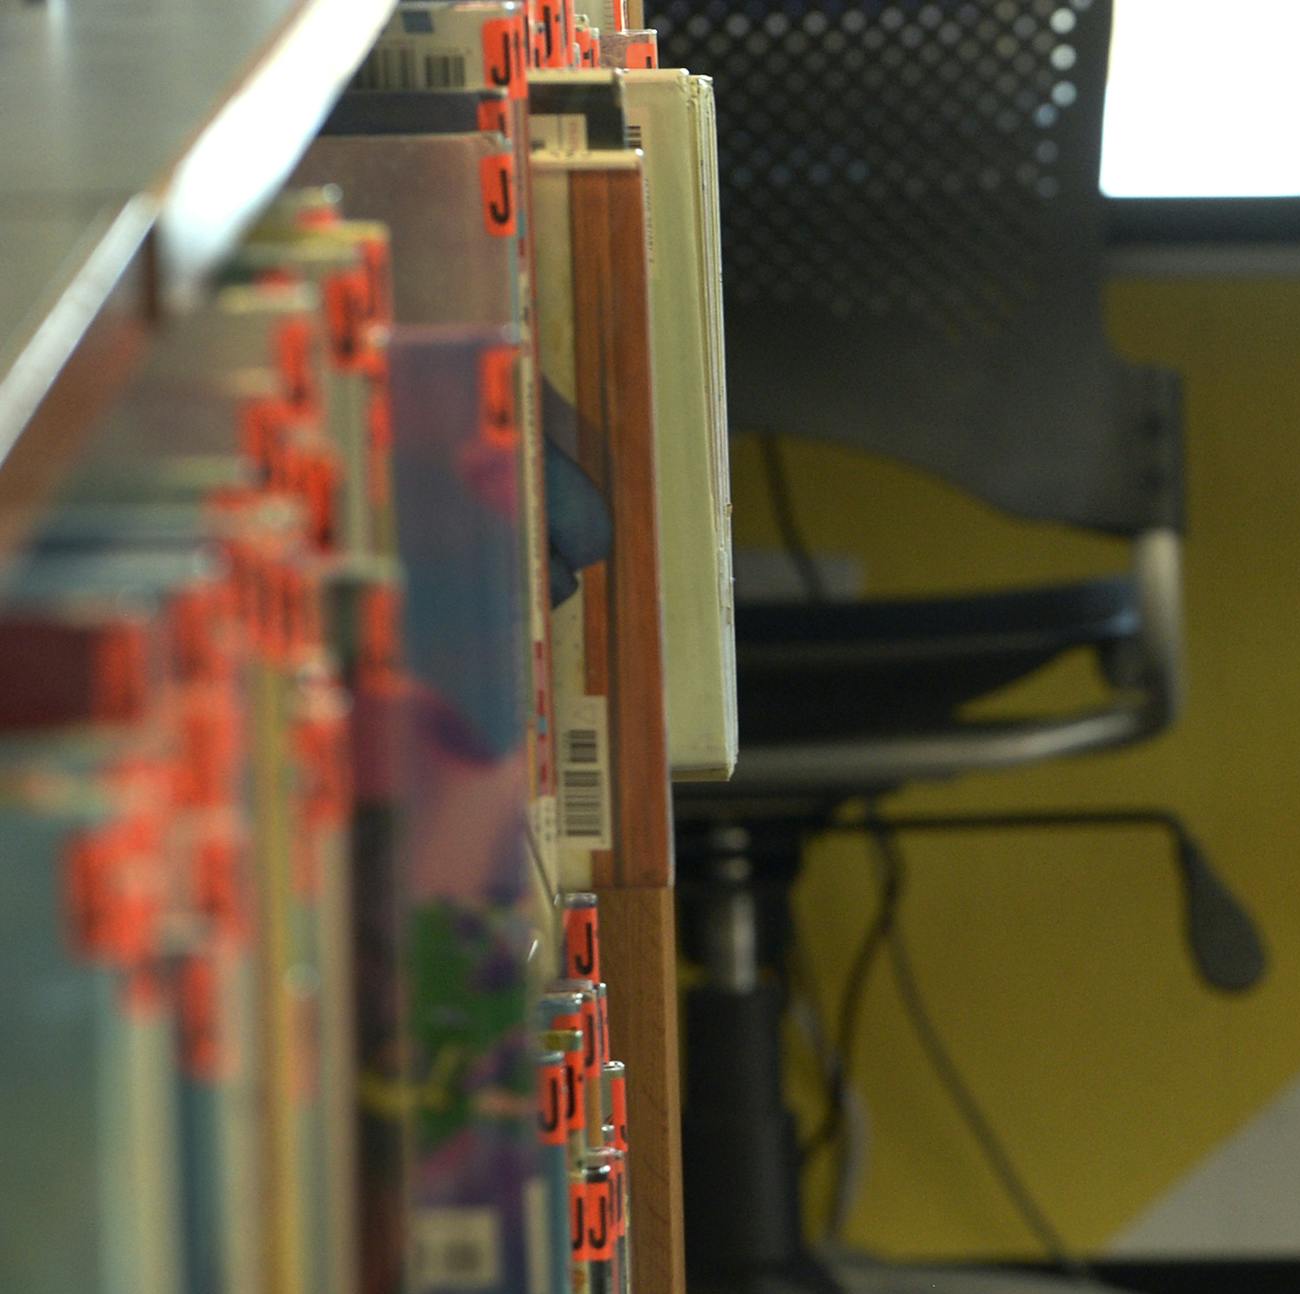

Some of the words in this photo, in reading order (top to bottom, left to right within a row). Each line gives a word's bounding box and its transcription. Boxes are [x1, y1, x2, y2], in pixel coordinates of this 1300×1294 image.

[491, 32, 510, 86] J
[490, 169, 511, 224] J
[574, 922, 593, 975] J
[537, 1077, 559, 1133] J
[571, 1196, 584, 1250] J
[588, 1194, 606, 1250] J
